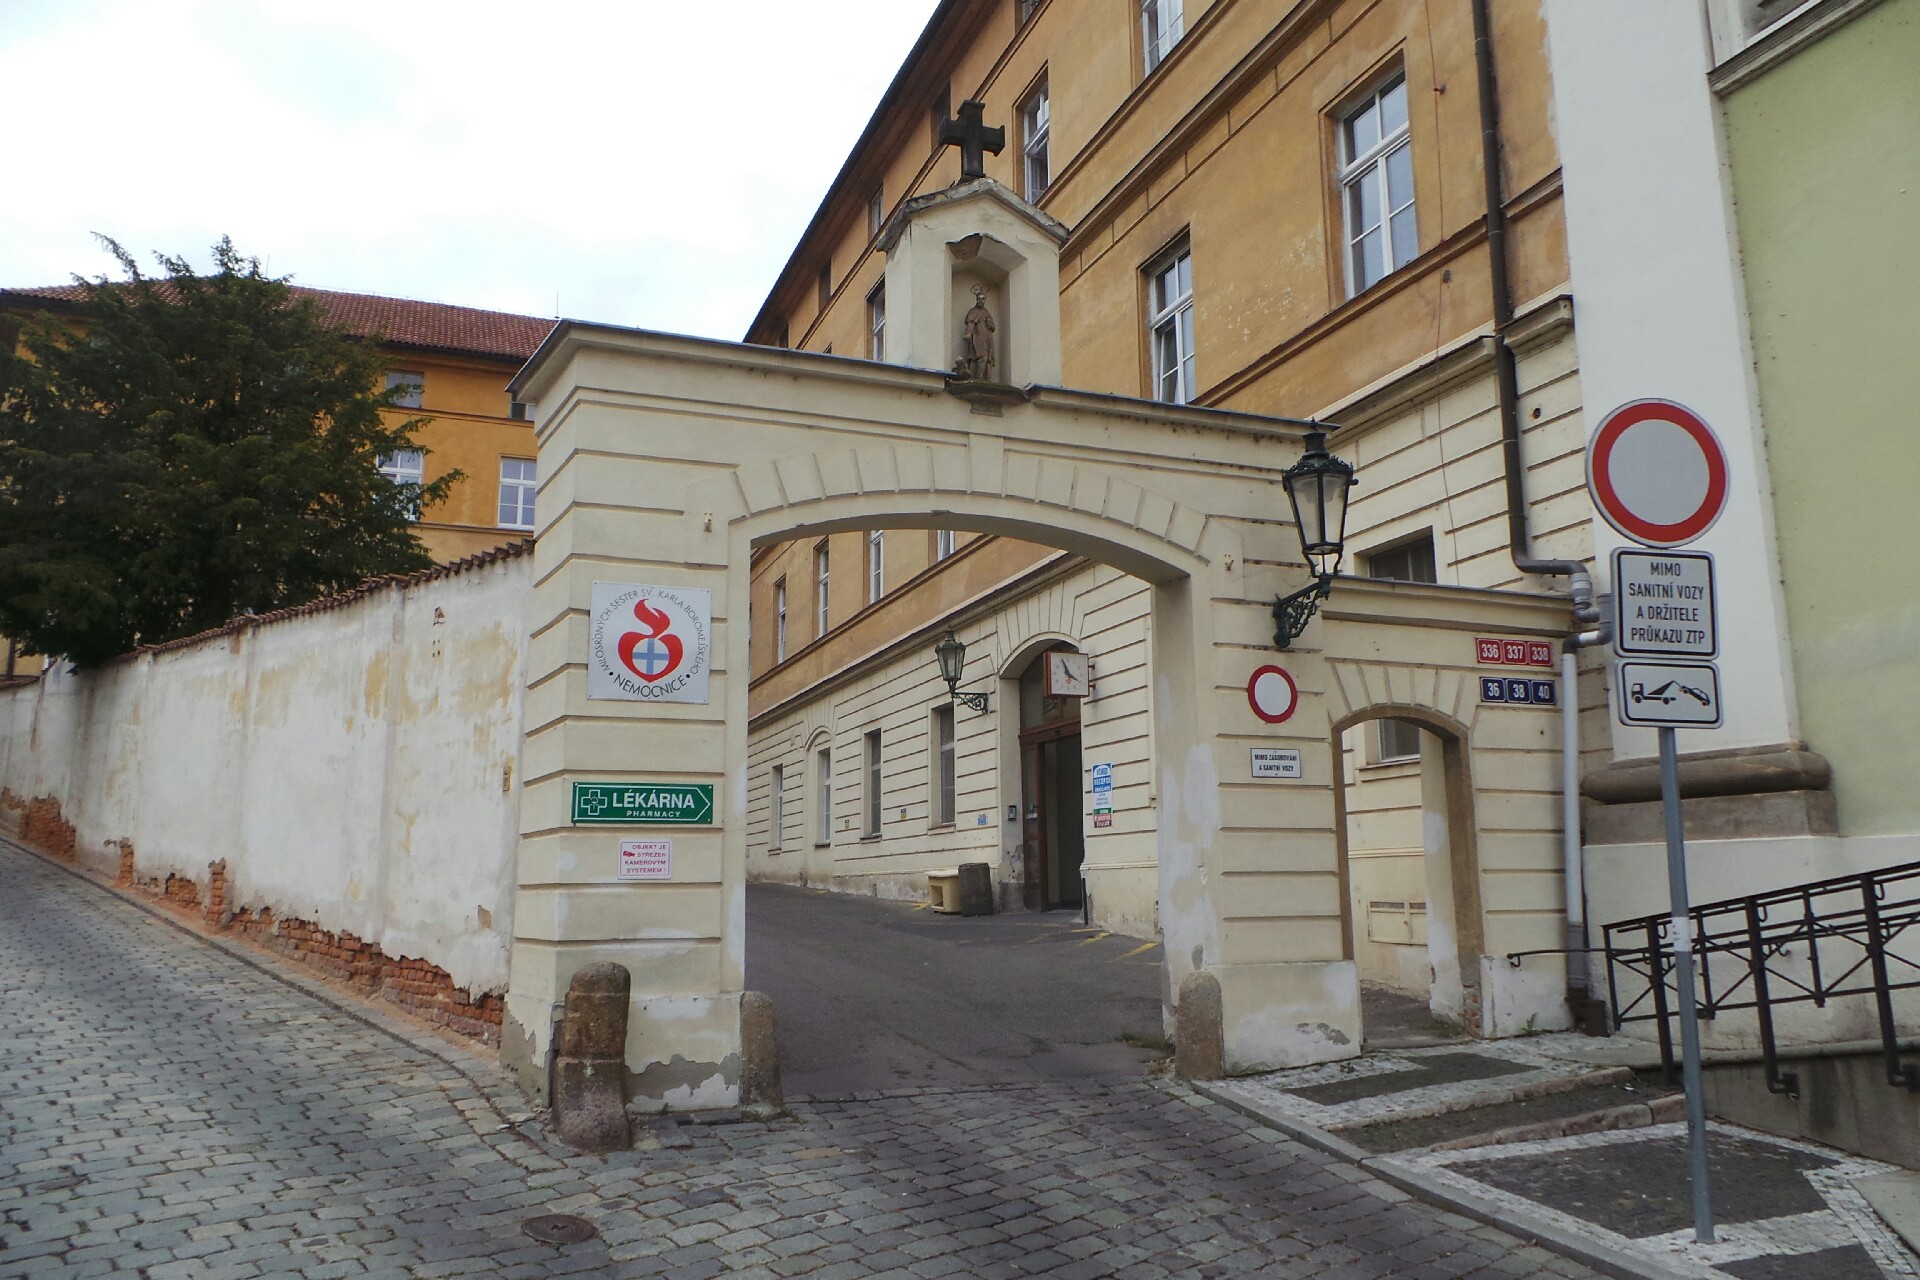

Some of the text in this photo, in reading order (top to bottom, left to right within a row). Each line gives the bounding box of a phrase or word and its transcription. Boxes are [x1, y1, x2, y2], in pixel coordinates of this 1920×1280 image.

[1650, 562, 1681, 577] MIMO
[610, 590, 639, 610] SESTER
[658, 590, 684, 608] KARLA
[1629, 581, 1704, 600] SANITNÍ VOZY
[1636, 603, 1699, 622] A DRŽITELE
[1631, 624, 1705, 644] PRŮKAZU ZTP
[1481, 643, 1549, 661] 336 337 338
[613, 673, 687, 698] NEMOCNICE
[1487, 682, 1550, 699] 36 38 40
[612, 789, 695, 809] LÉKÁRNA
[626, 810, 681, 818] PHARMACY
